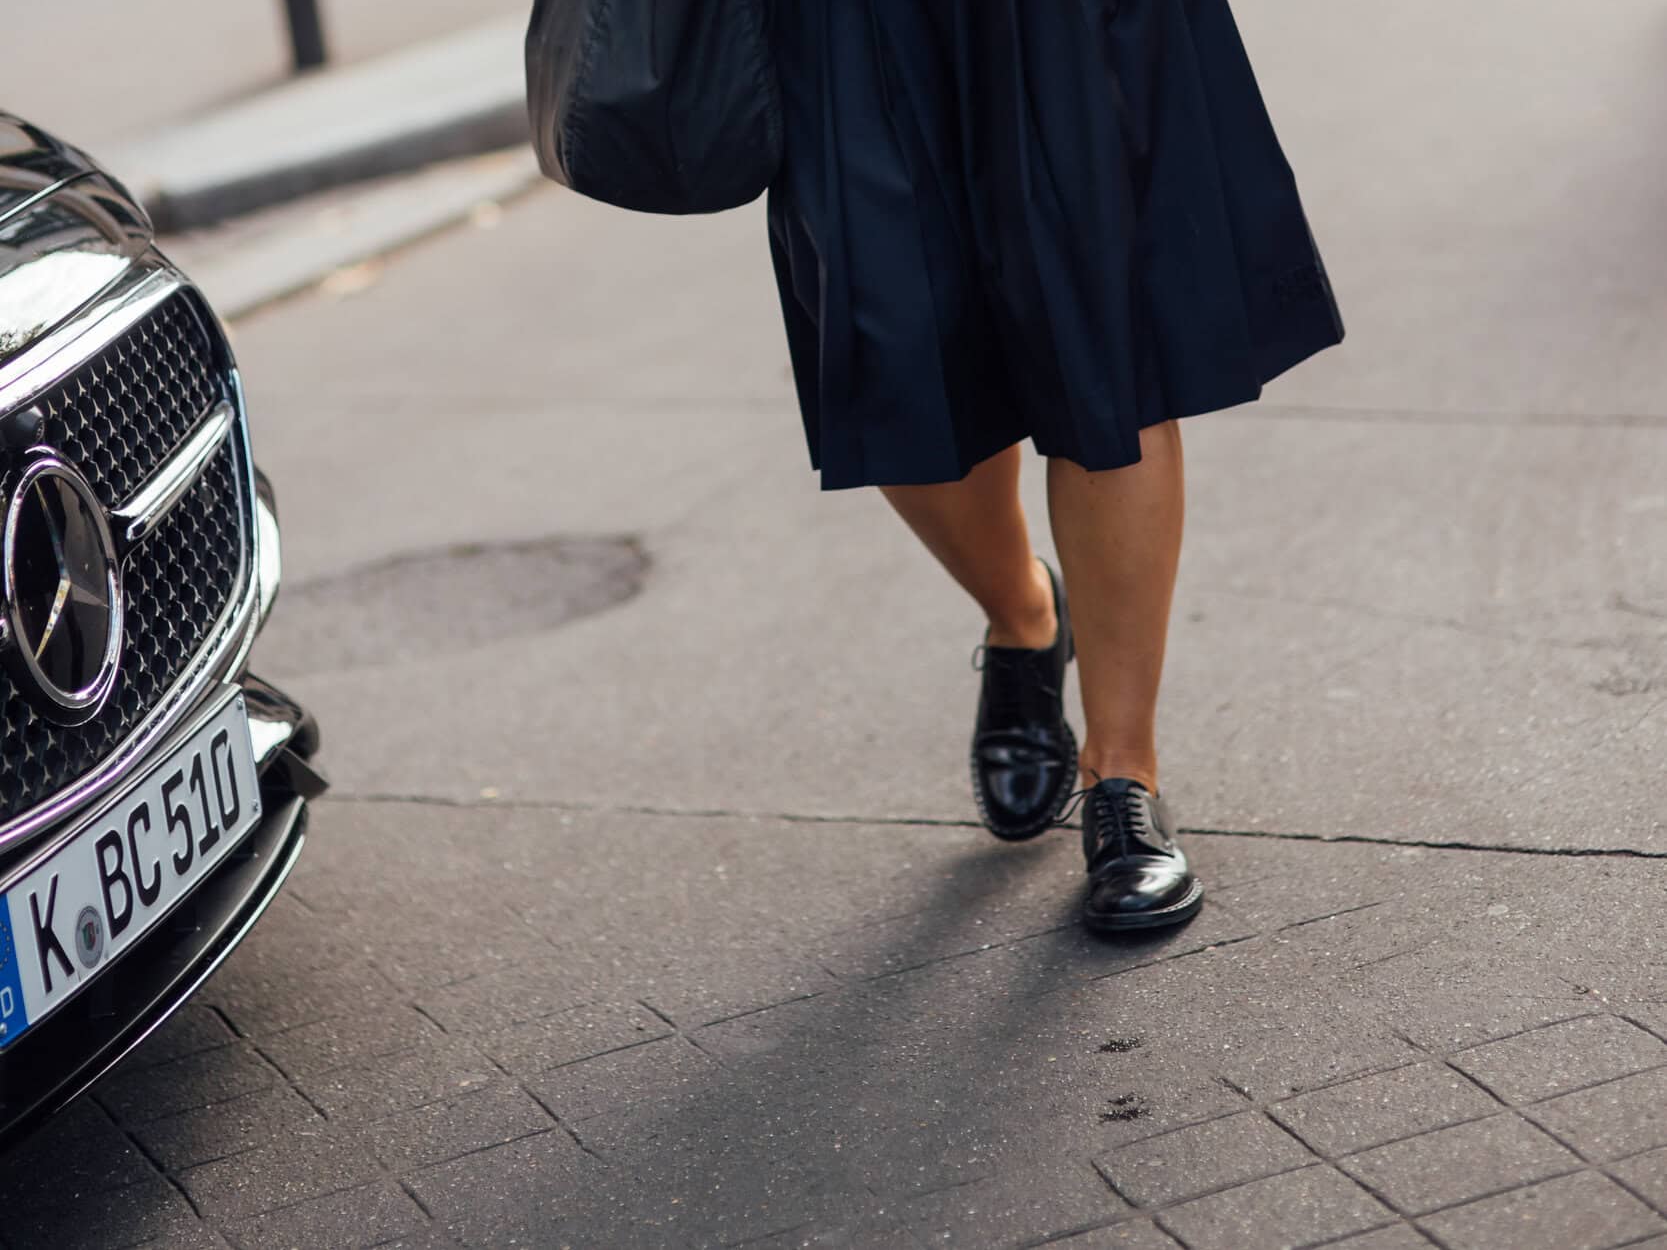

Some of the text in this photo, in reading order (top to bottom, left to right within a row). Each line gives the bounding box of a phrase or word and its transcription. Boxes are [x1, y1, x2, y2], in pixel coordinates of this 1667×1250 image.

[28, 728, 241, 995] K BC 510
[0, 985, 15, 1019] D
